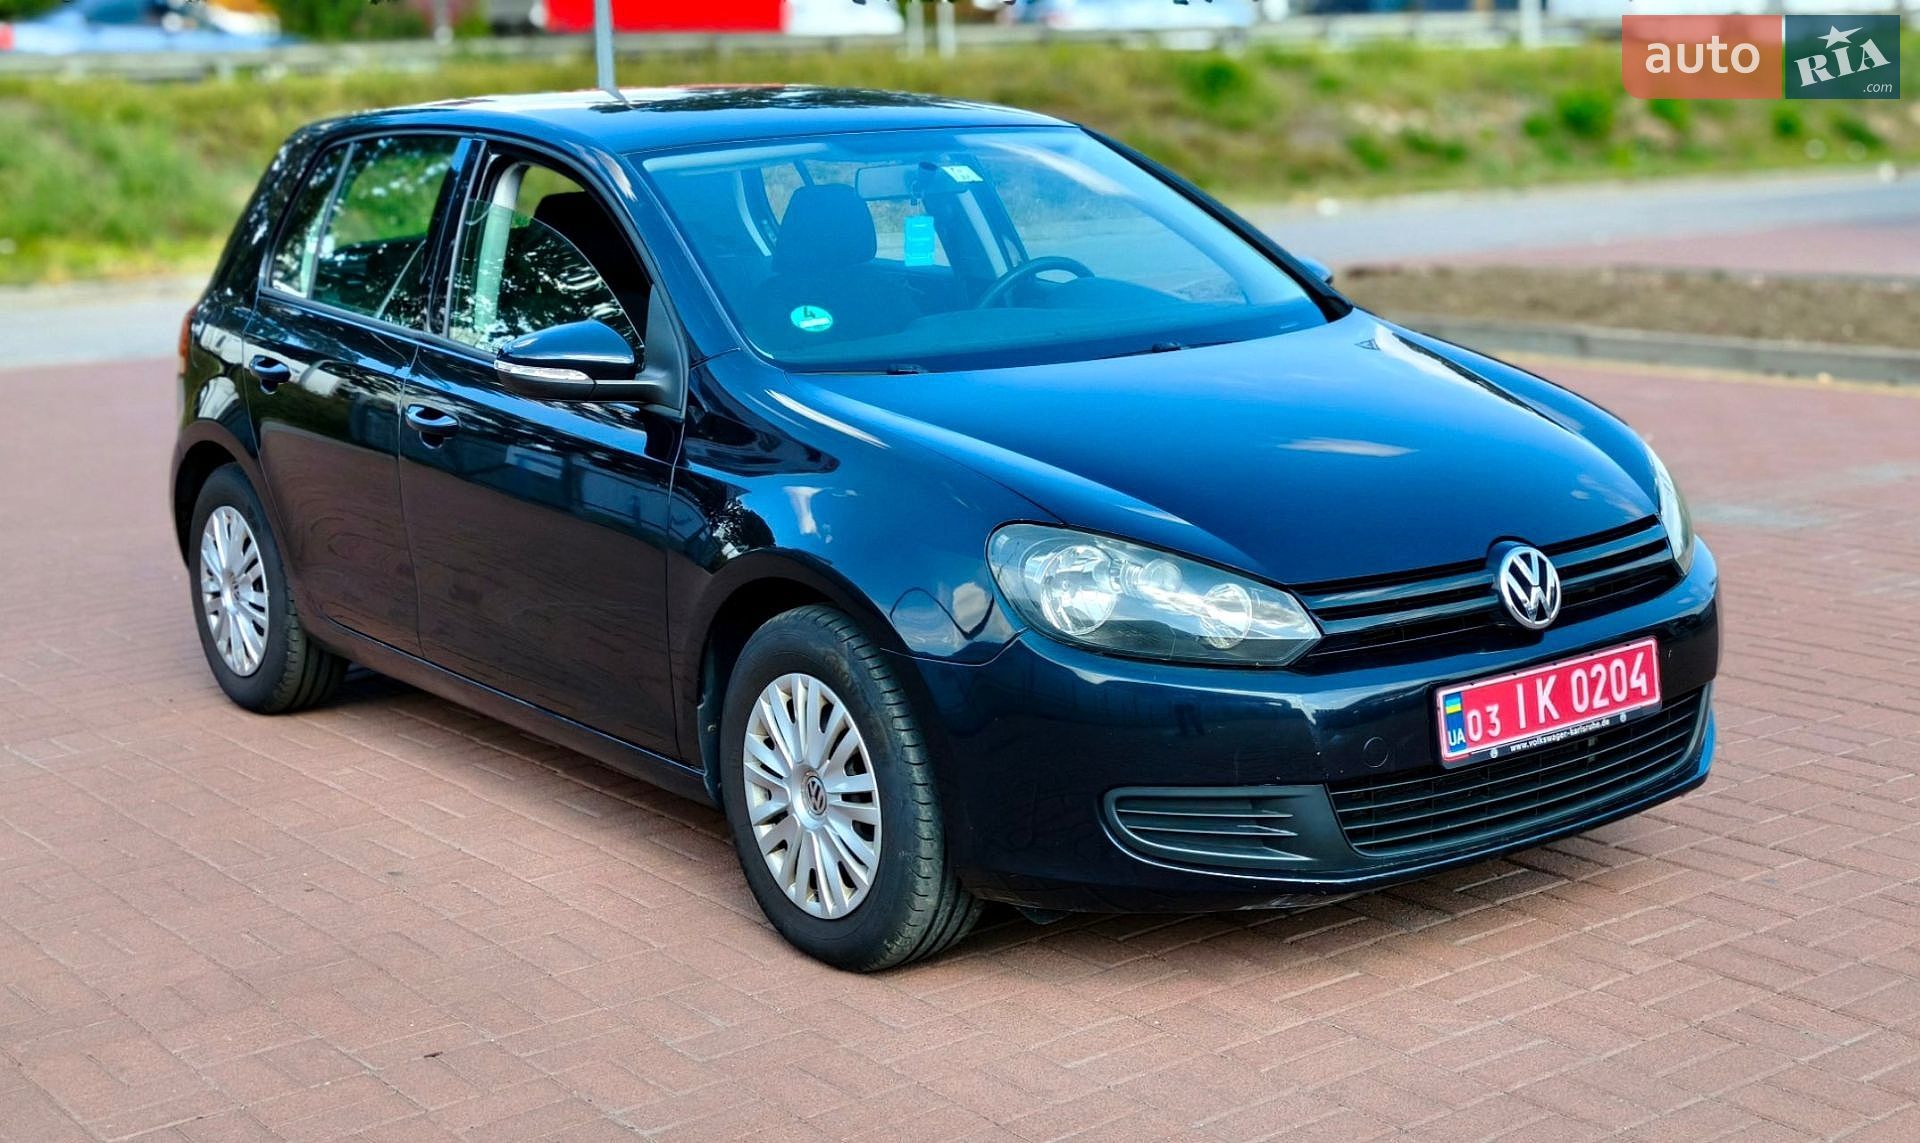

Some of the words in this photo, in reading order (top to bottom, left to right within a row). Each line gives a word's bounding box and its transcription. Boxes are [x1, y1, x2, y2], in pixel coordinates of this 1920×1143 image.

[1467, 703, 1501, 742] 03
[1516, 674, 1560, 729] IK
[1570, 652, 1648, 713] 0204
[1447, 728, 1466, 746] UA
